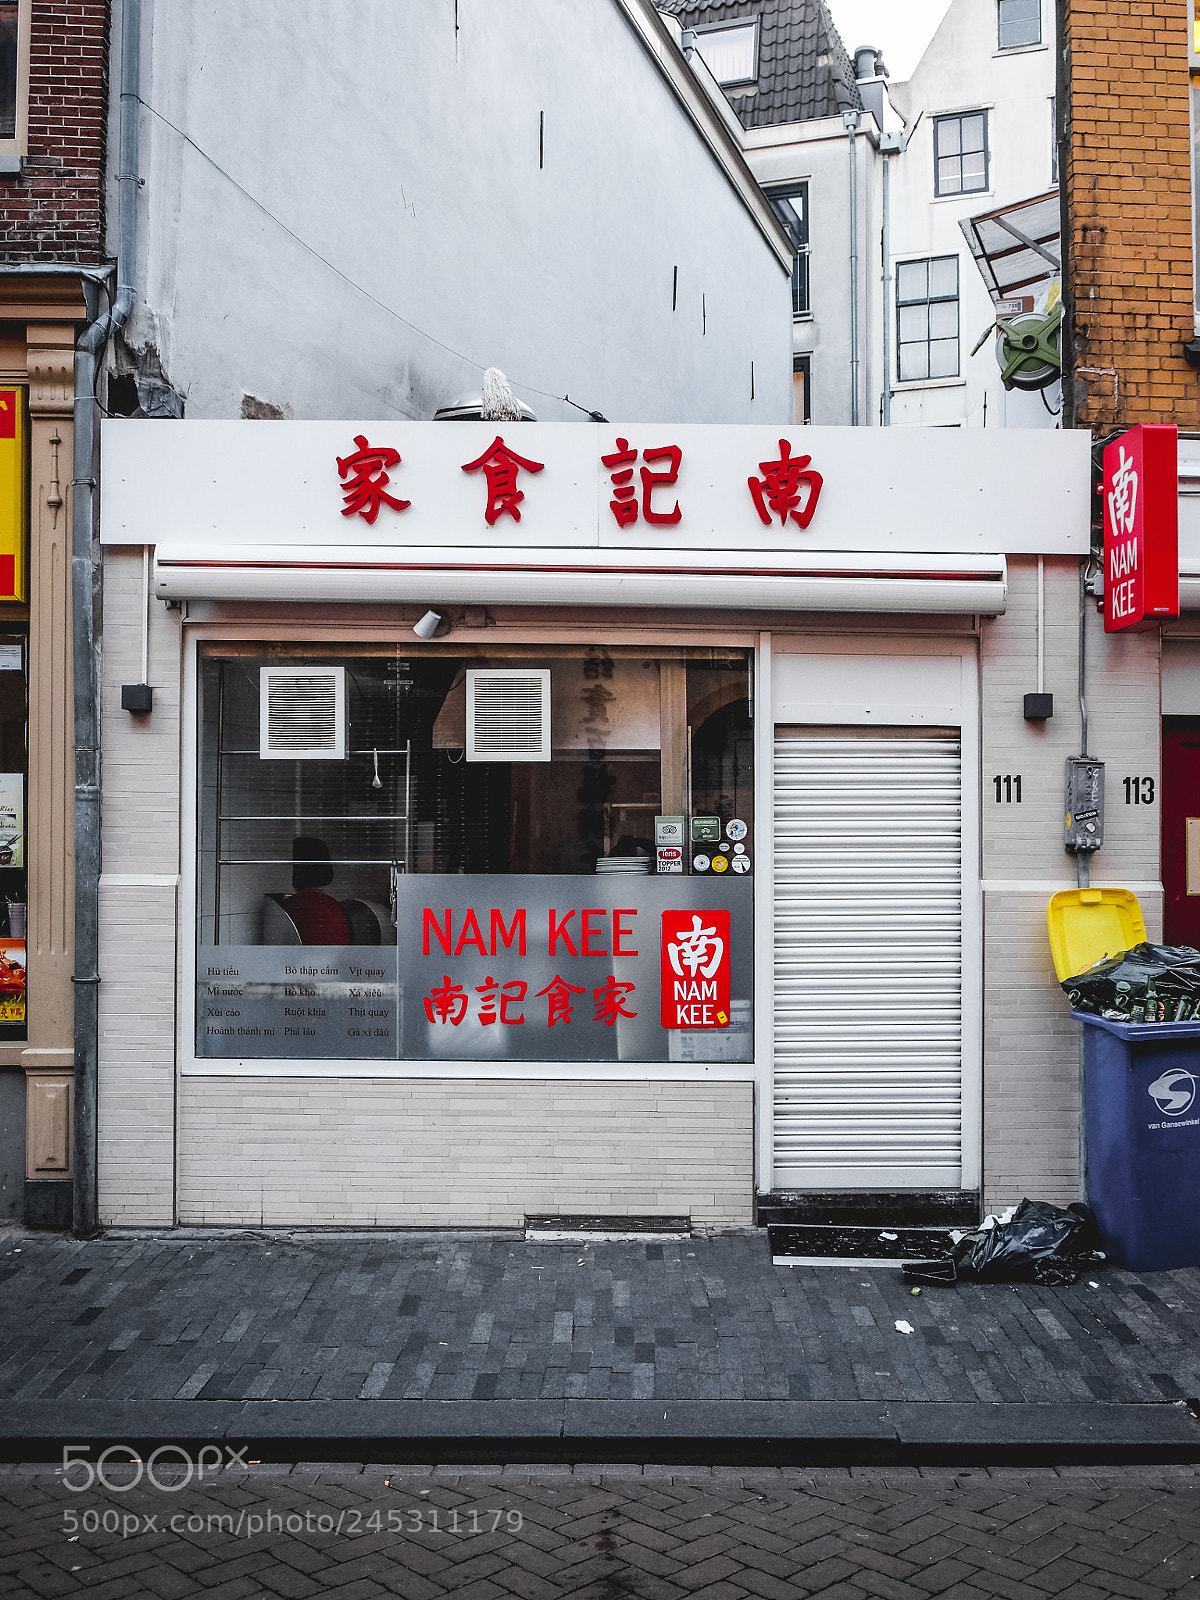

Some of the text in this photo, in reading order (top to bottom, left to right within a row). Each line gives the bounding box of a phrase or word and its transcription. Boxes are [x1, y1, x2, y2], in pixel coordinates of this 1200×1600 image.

[1107, 445, 1138, 537] 南
[1110, 536, 1138, 581] NAM
[1112, 579, 1136, 620] KEE
[993, 774, 1022, 803] 111
[1122, 776, 1155, 805] 113
[422, 907, 639, 957] NAM KEE
[667, 914, 724, 979] 南
[349, 966, 386, 978] Vịt quay
[300, 987, 316, 996] kho
[422, 974, 639, 1028] 南記食家
[673, 980, 718, 1001] NAM
[368, 1009, 390, 1018] quay
[676, 1004, 715, 1025] KEE
